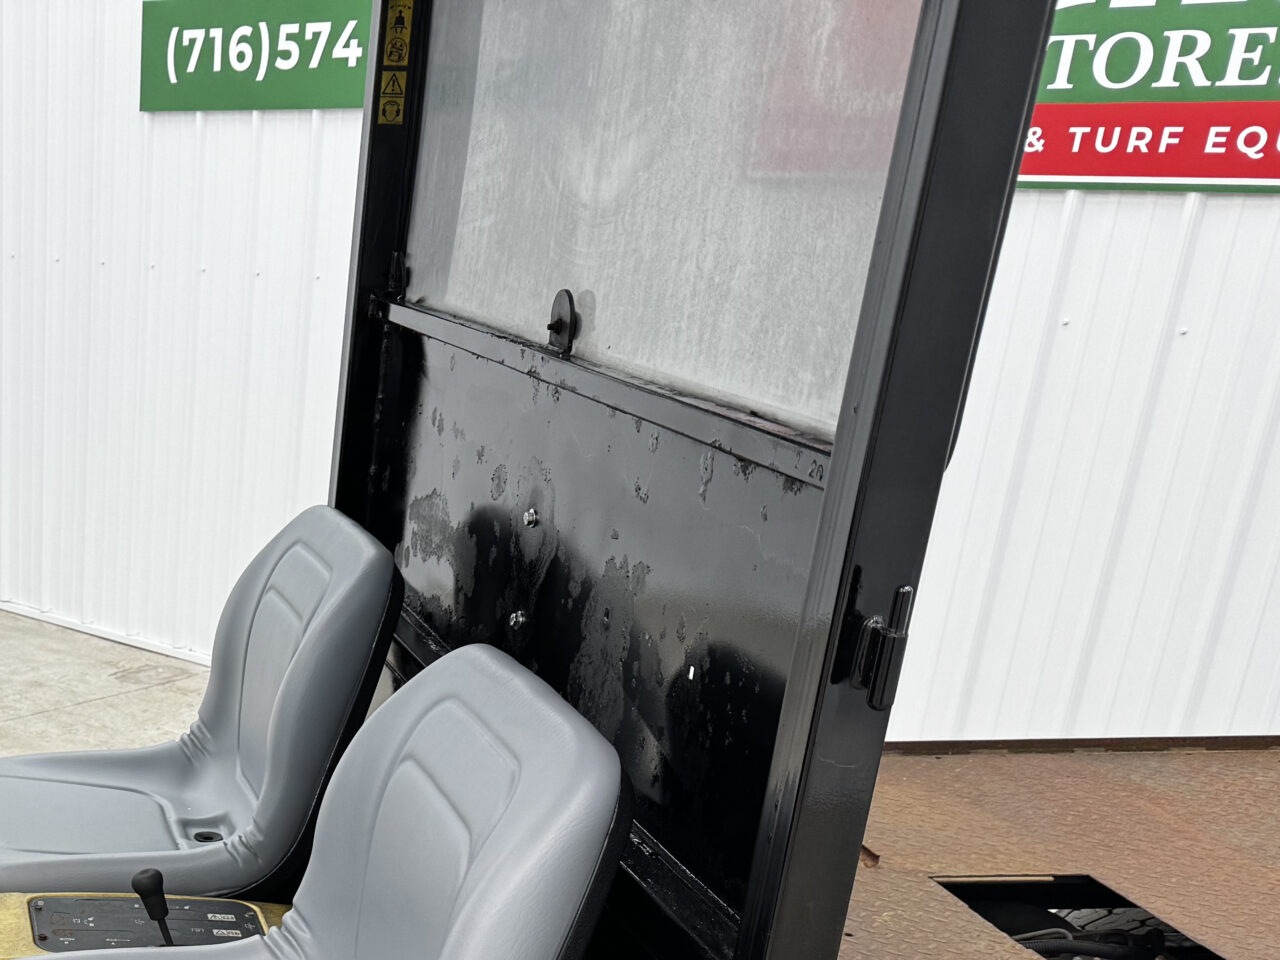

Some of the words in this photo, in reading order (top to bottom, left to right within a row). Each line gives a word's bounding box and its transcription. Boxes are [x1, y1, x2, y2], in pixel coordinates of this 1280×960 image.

[167, 20, 363, 84] (716)574
[1046, 27, 1280, 89] TORE
[1069, 127, 1184, 153] TURF
[1204, 126, 1280, 159] EQ
